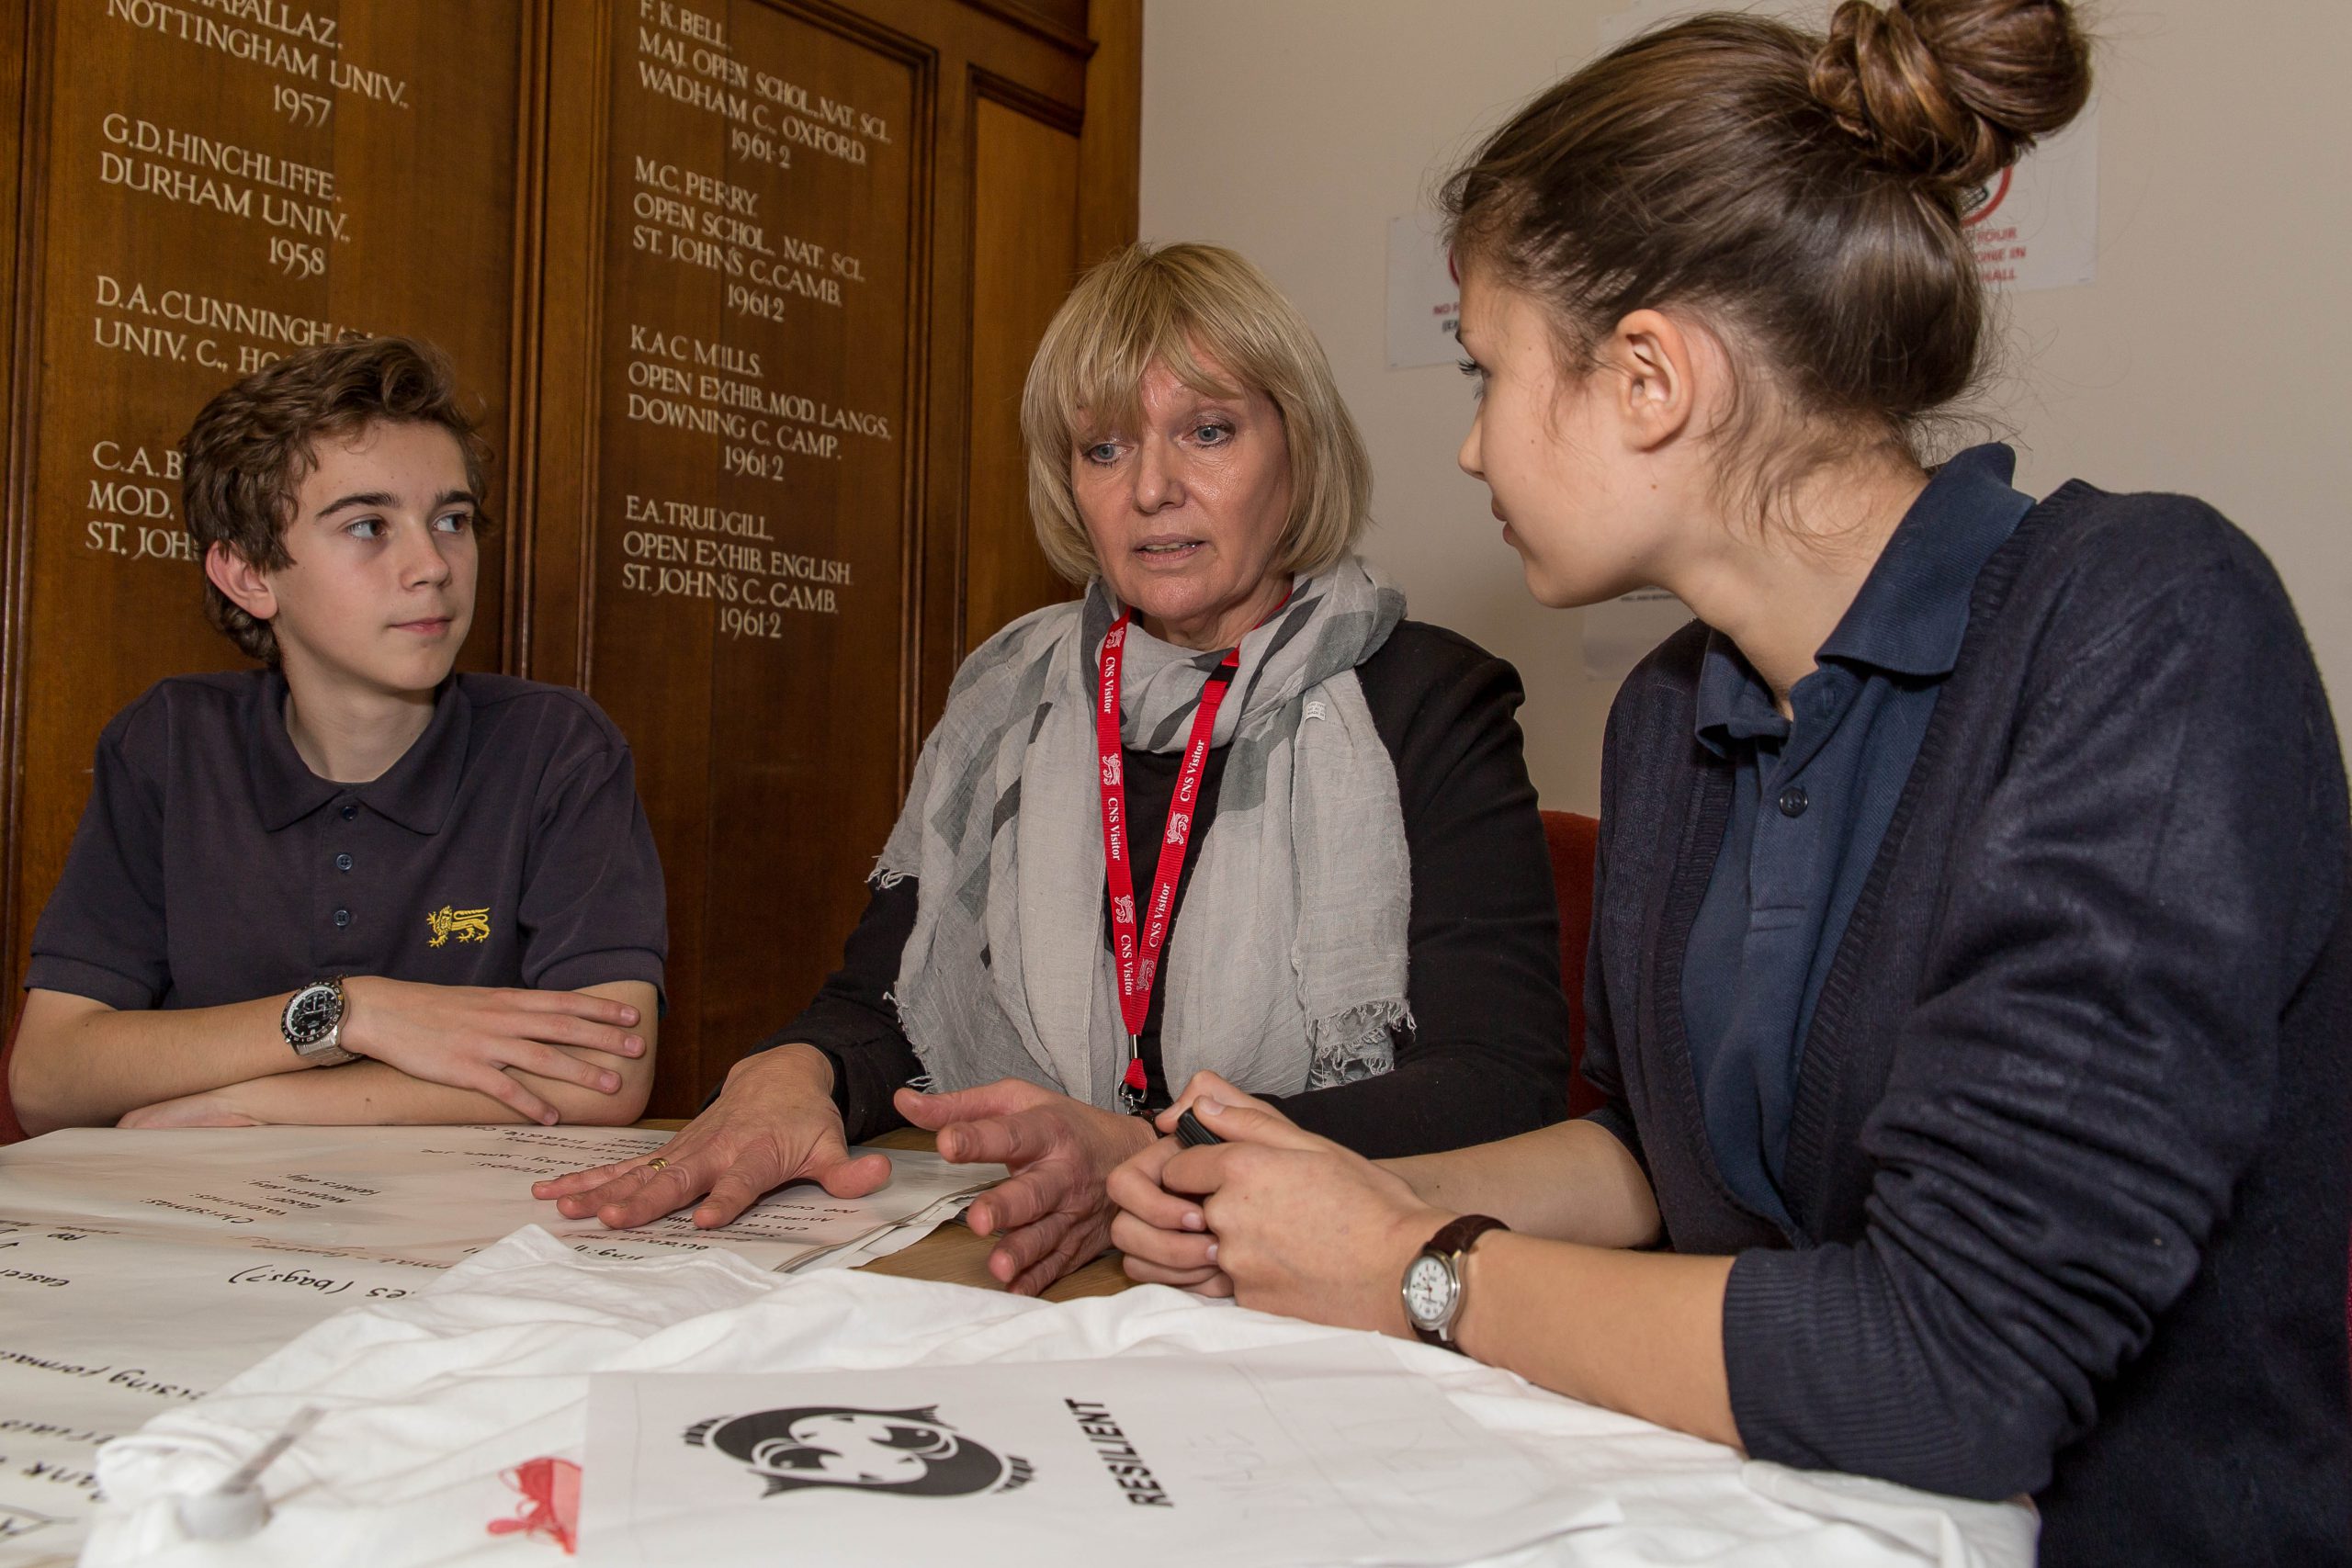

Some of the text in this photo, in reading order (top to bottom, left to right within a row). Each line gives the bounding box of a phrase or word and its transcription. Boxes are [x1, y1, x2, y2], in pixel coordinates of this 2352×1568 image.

[107, 0, 319, 81] NOTTINGHAM
[191, 0, 344, 50] APALLAZ.
[693, 49, 748, 90] OPEN
[273, 85, 332, 128] 1957
[639, 61, 747, 123] WADHAM
[100, 151, 254, 219] DURHAM
[633, 192, 695, 231] OPEN
[268, 236, 325, 280] 1958
[95, 317, 187, 362] UNIV.
[628, 361, 693, 396] OPEN
[628, 392, 747, 441] DOWNING
[92, 440, 187, 480] C.A.B
[87, 479, 175, 521] MOD.
[85, 521, 127, 556] ST.
[623, 530, 689, 563] OPEN
[622, 562, 653, 592] ST.
[1103, 656, 1116, 714] CNS Visitor
[1180, 739, 1205, 803] CNS Visitor
[1107, 797, 1121, 862] CNS Visitor
[1148, 882, 1171, 949] CNS Visitor
[1120, 933, 1134, 997] CNS Visitor
[139, 1198, 254, 1224] Christmas:
[608, 1236, 710, 1250] olidays:
[1065, 1397, 1175, 1507] RESILIENT
